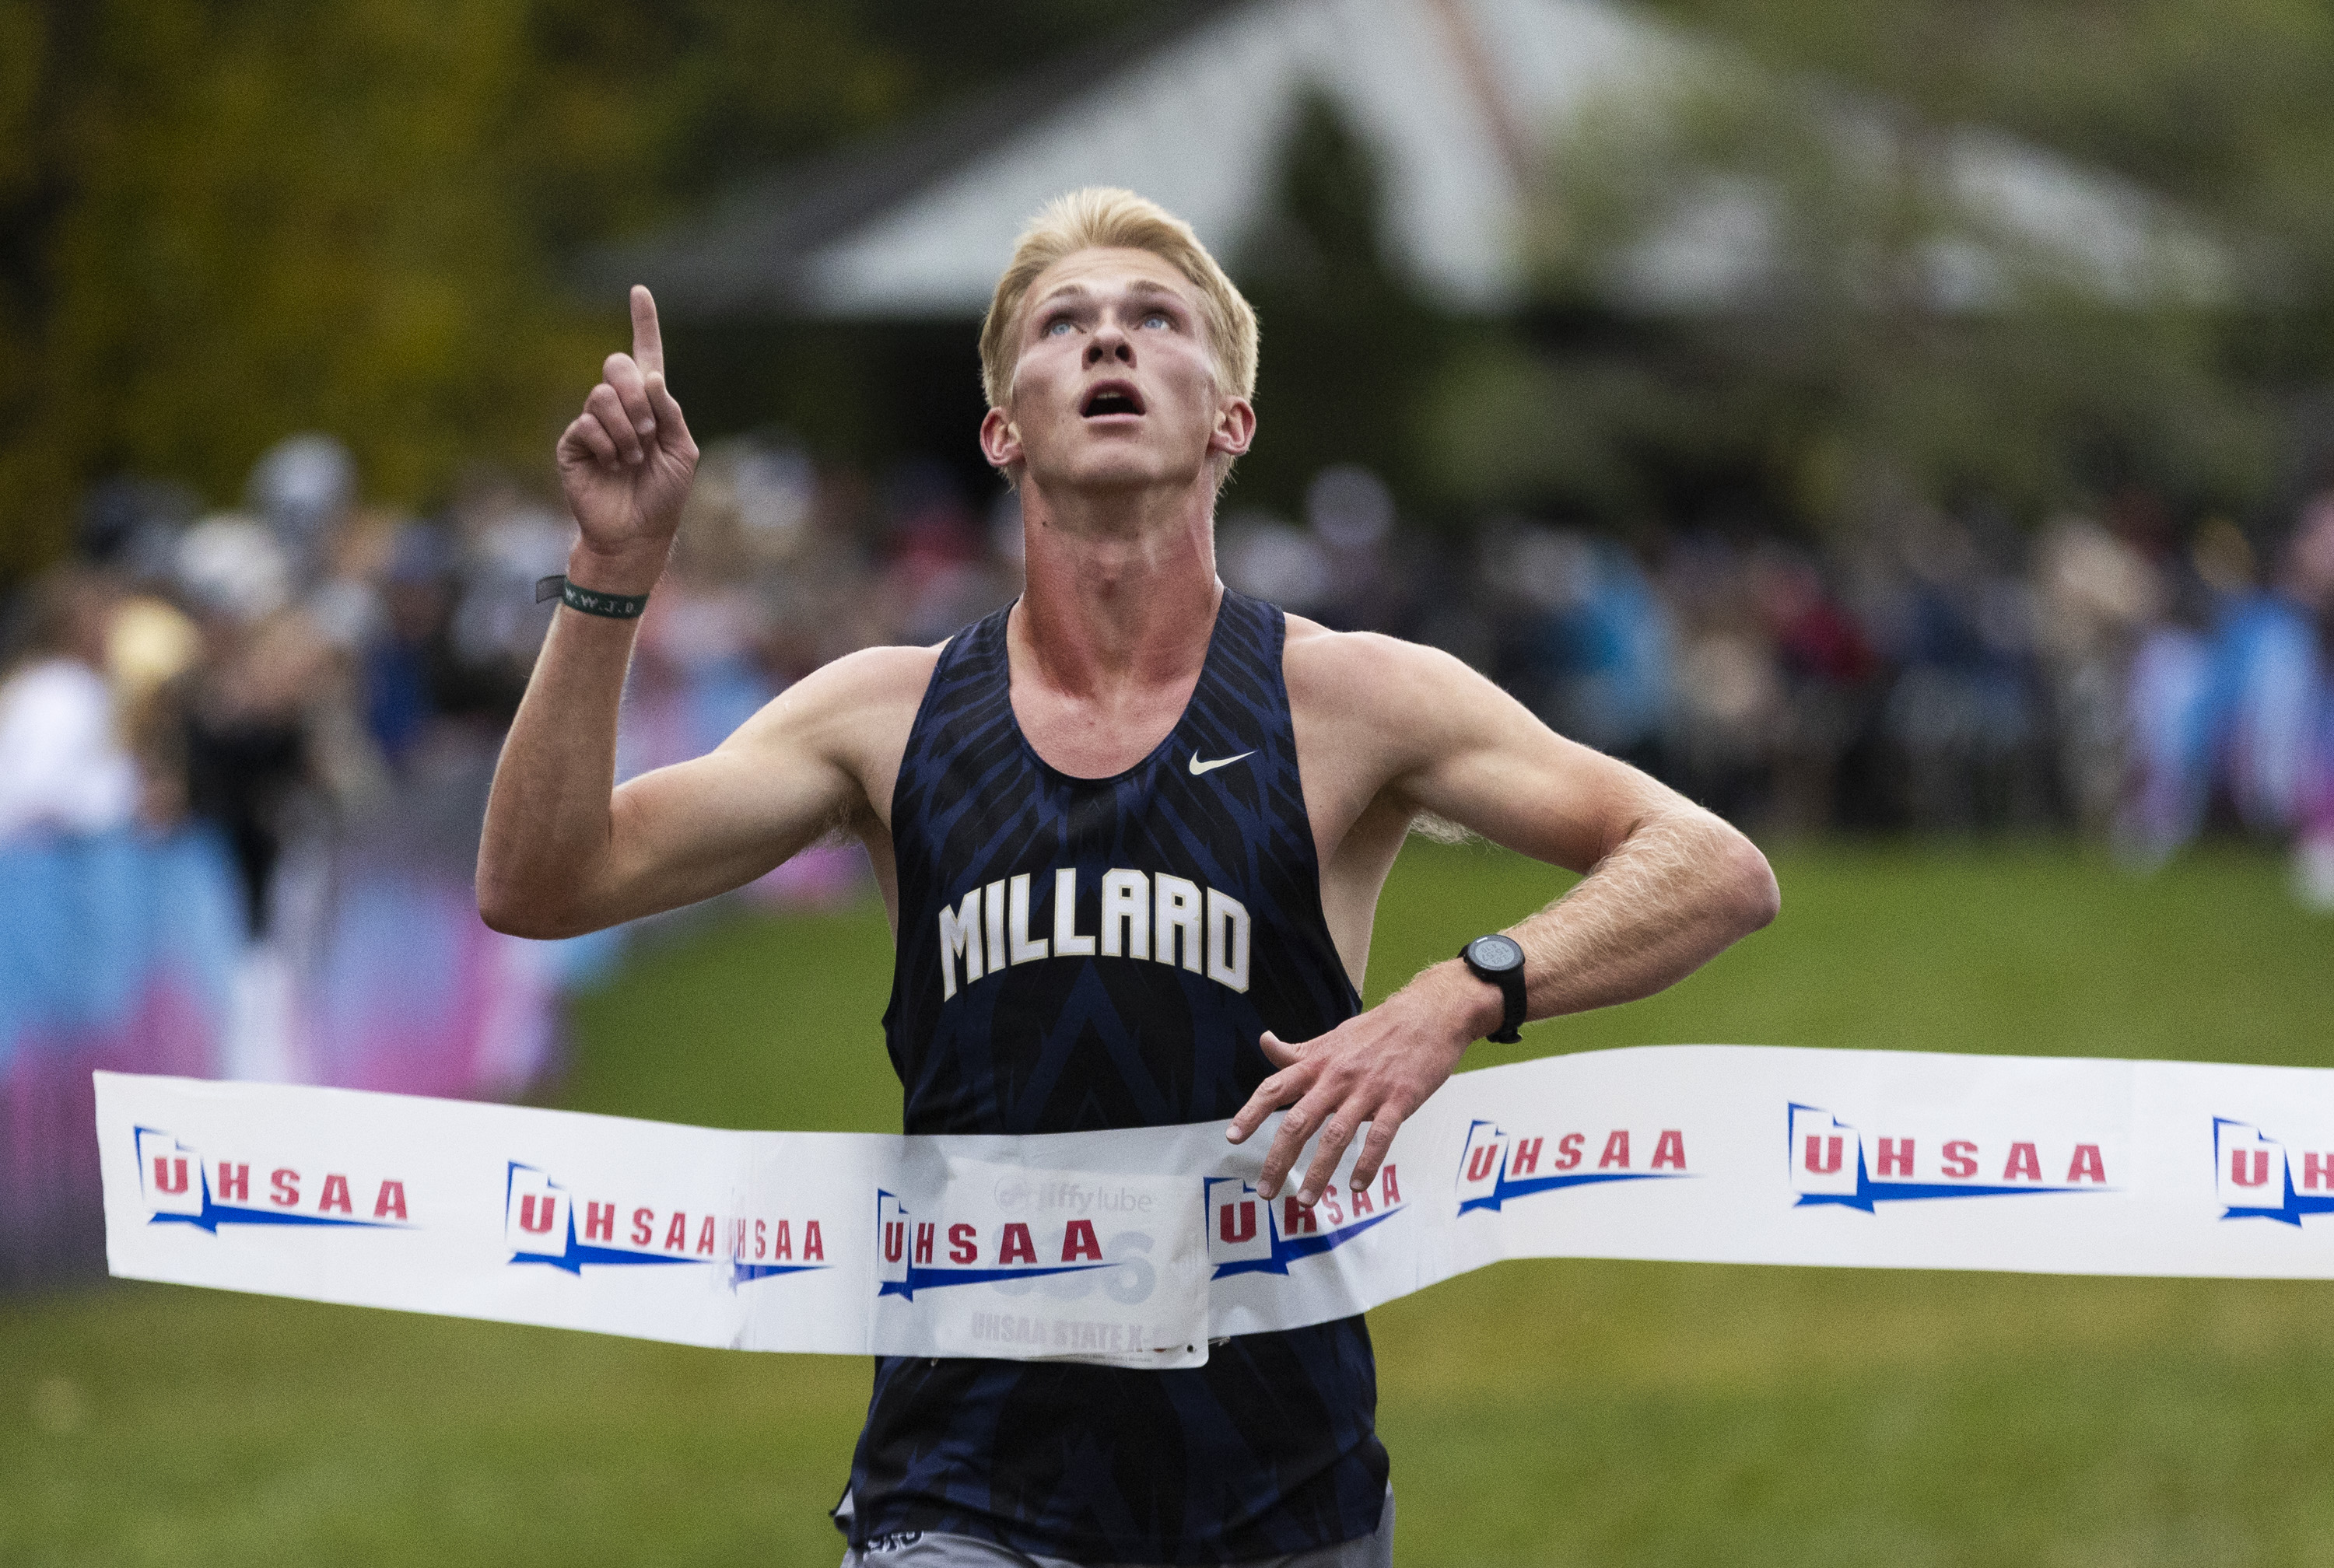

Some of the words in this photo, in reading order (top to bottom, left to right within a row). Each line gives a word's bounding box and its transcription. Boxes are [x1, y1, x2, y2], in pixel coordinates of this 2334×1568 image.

[938, 867, 1251, 1003] MILLARD
[1467, 1130, 1687, 1182] UHSAA
[1805, 1136, 2106, 1182] UHSAA
[153, 1157, 408, 1220] UHSAA
[1097, 1185, 1153, 1213] lube
[1221, 1164, 1401, 1244] UHSAA
[519, 1194, 715, 1255] UHSAA
[885, 1219, 1102, 1265] UHSAA
[971, 1311, 1047, 1346] UHSAA
[1052, 1319, 1123, 1351] STATE
